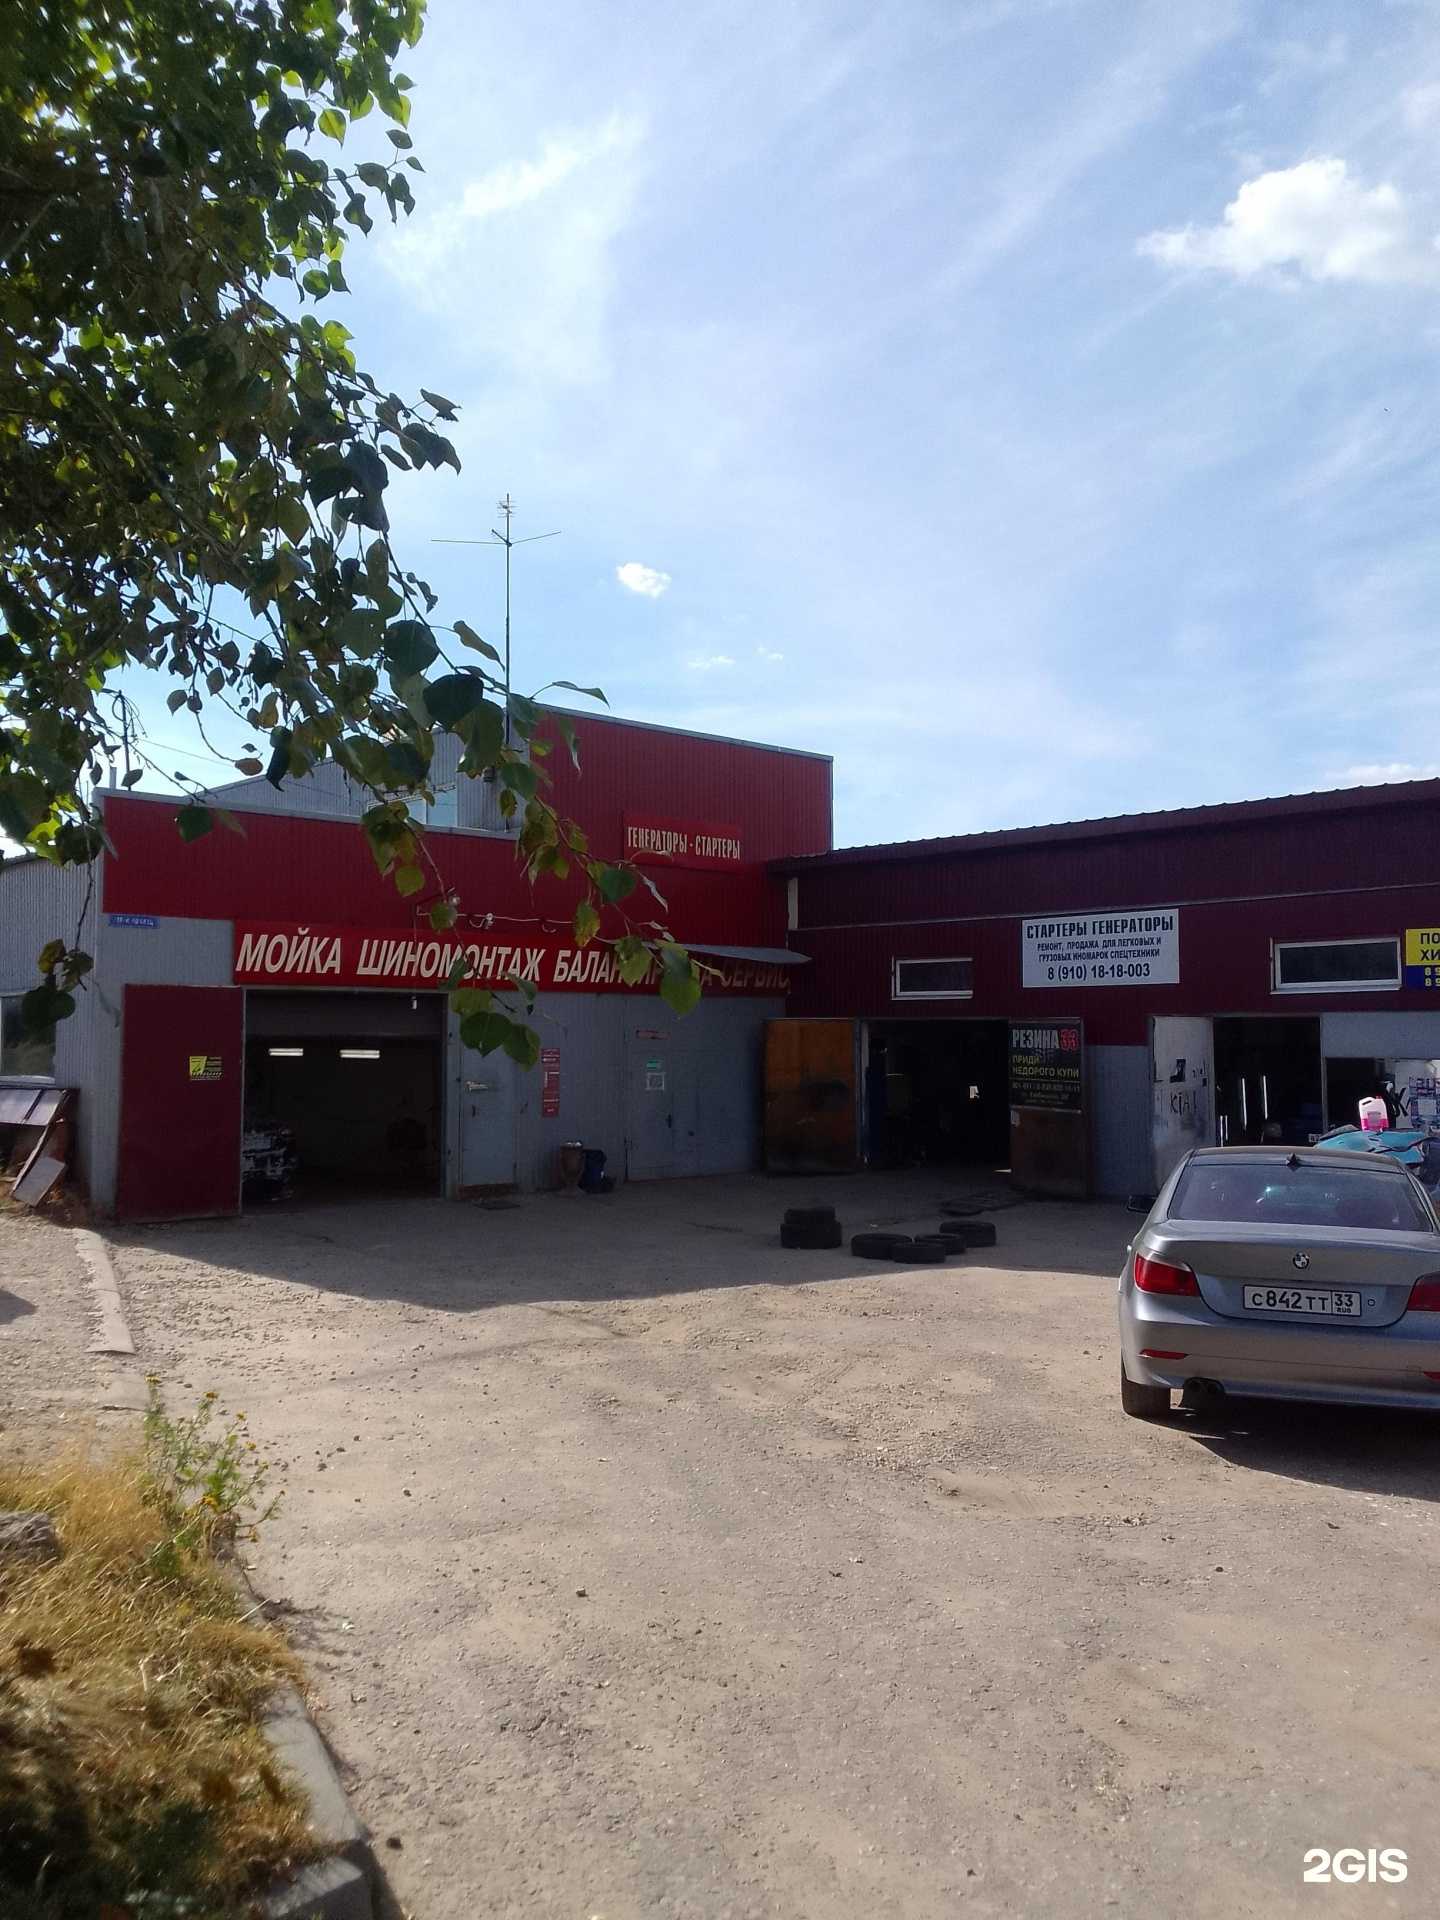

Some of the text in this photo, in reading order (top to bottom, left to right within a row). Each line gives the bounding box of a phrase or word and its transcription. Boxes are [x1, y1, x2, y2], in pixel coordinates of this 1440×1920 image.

[628, 826, 688, 853] ГЕНЕРАТОРЫ
[695, 834, 741, 860] СТАРТЕРЫ
[1026, 915, 1174, 939] СТАРТЕРЫ ГЕНЕРАТОРЫ
[1037, 936, 1162, 952] РЕМОНТ, ПРОДАЖА ДЛЯ ЛЕГКОВЫХ И
[235, 927, 342, 974] МОЙКА
[356, 939, 546, 982] ШИНОМОНТАЖ
[1038, 948, 1160, 963] ГРУЗОВЫХ ИНОМАРОК СПЕЦТЕХНИКИ
[1047, 963, 1151, 981] 8 (910) 18-18-003
[1057, 1068, 1080, 1079] КУПИ
[1334, 1293, 1354, 1307] 33
